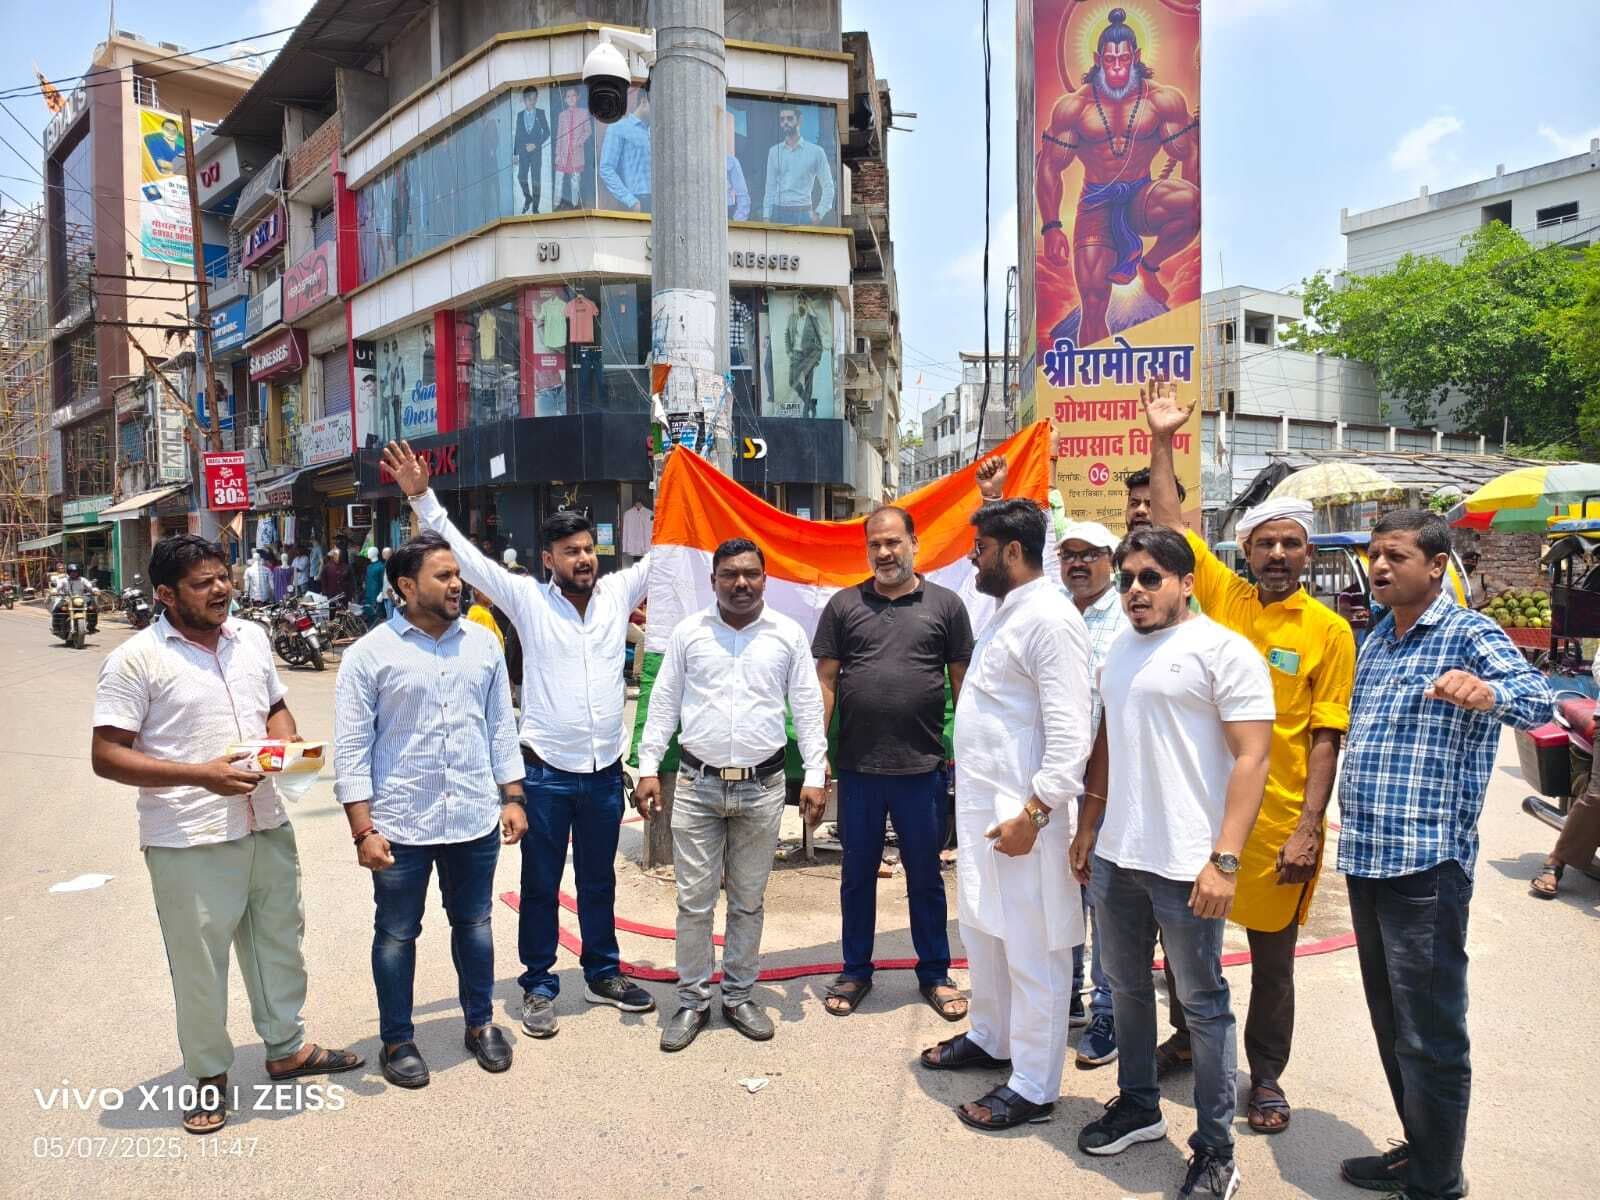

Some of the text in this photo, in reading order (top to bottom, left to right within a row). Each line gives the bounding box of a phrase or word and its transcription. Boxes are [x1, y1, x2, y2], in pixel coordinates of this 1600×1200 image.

[536, 241, 560, 263] SD
[1042, 336, 1194, 388] श्रीरामोत्सव
[1057, 434, 1125, 459] हाप्रसाद
[214, 478, 243, 489] FLAT
[1090, 467, 1108, 481] 06
